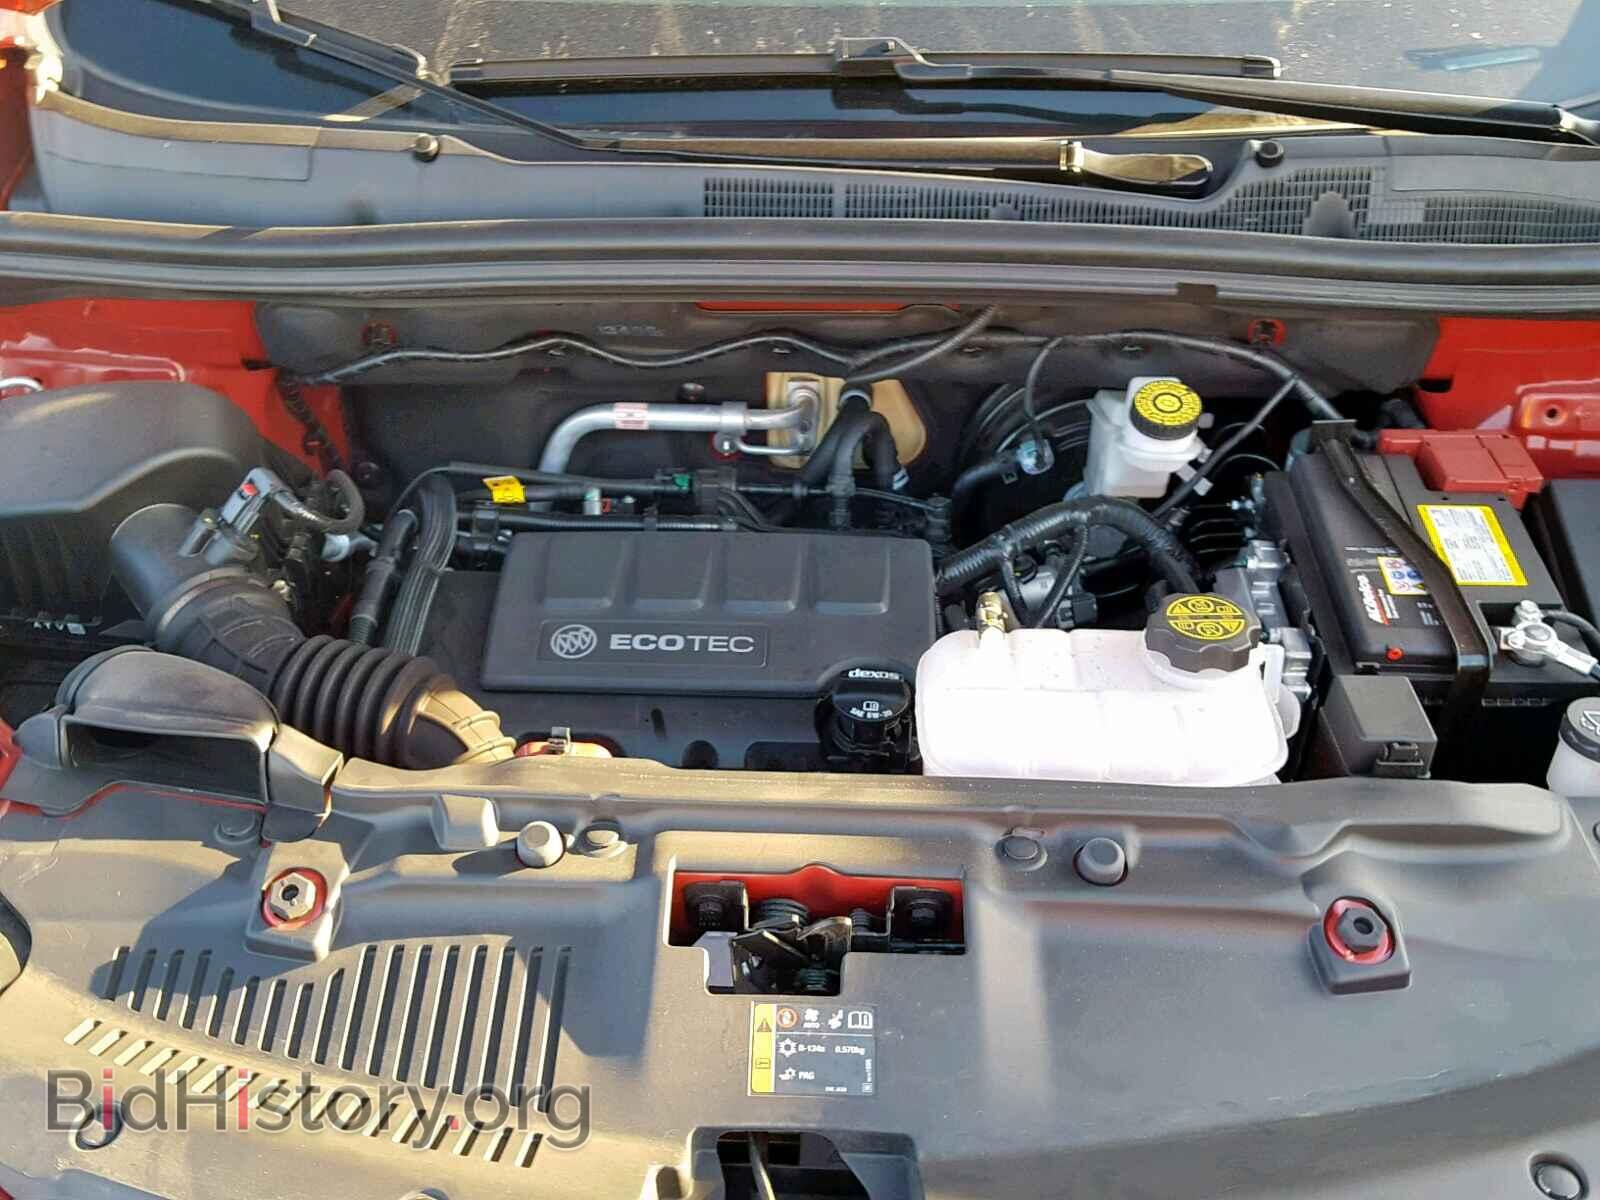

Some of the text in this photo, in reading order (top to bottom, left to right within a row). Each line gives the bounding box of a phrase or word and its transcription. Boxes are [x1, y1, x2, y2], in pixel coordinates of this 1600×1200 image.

[609, 633, 755, 653] ECOTEC
[847, 668, 900, 680] dexos
[798, 1071, 815, 1080] PAG
